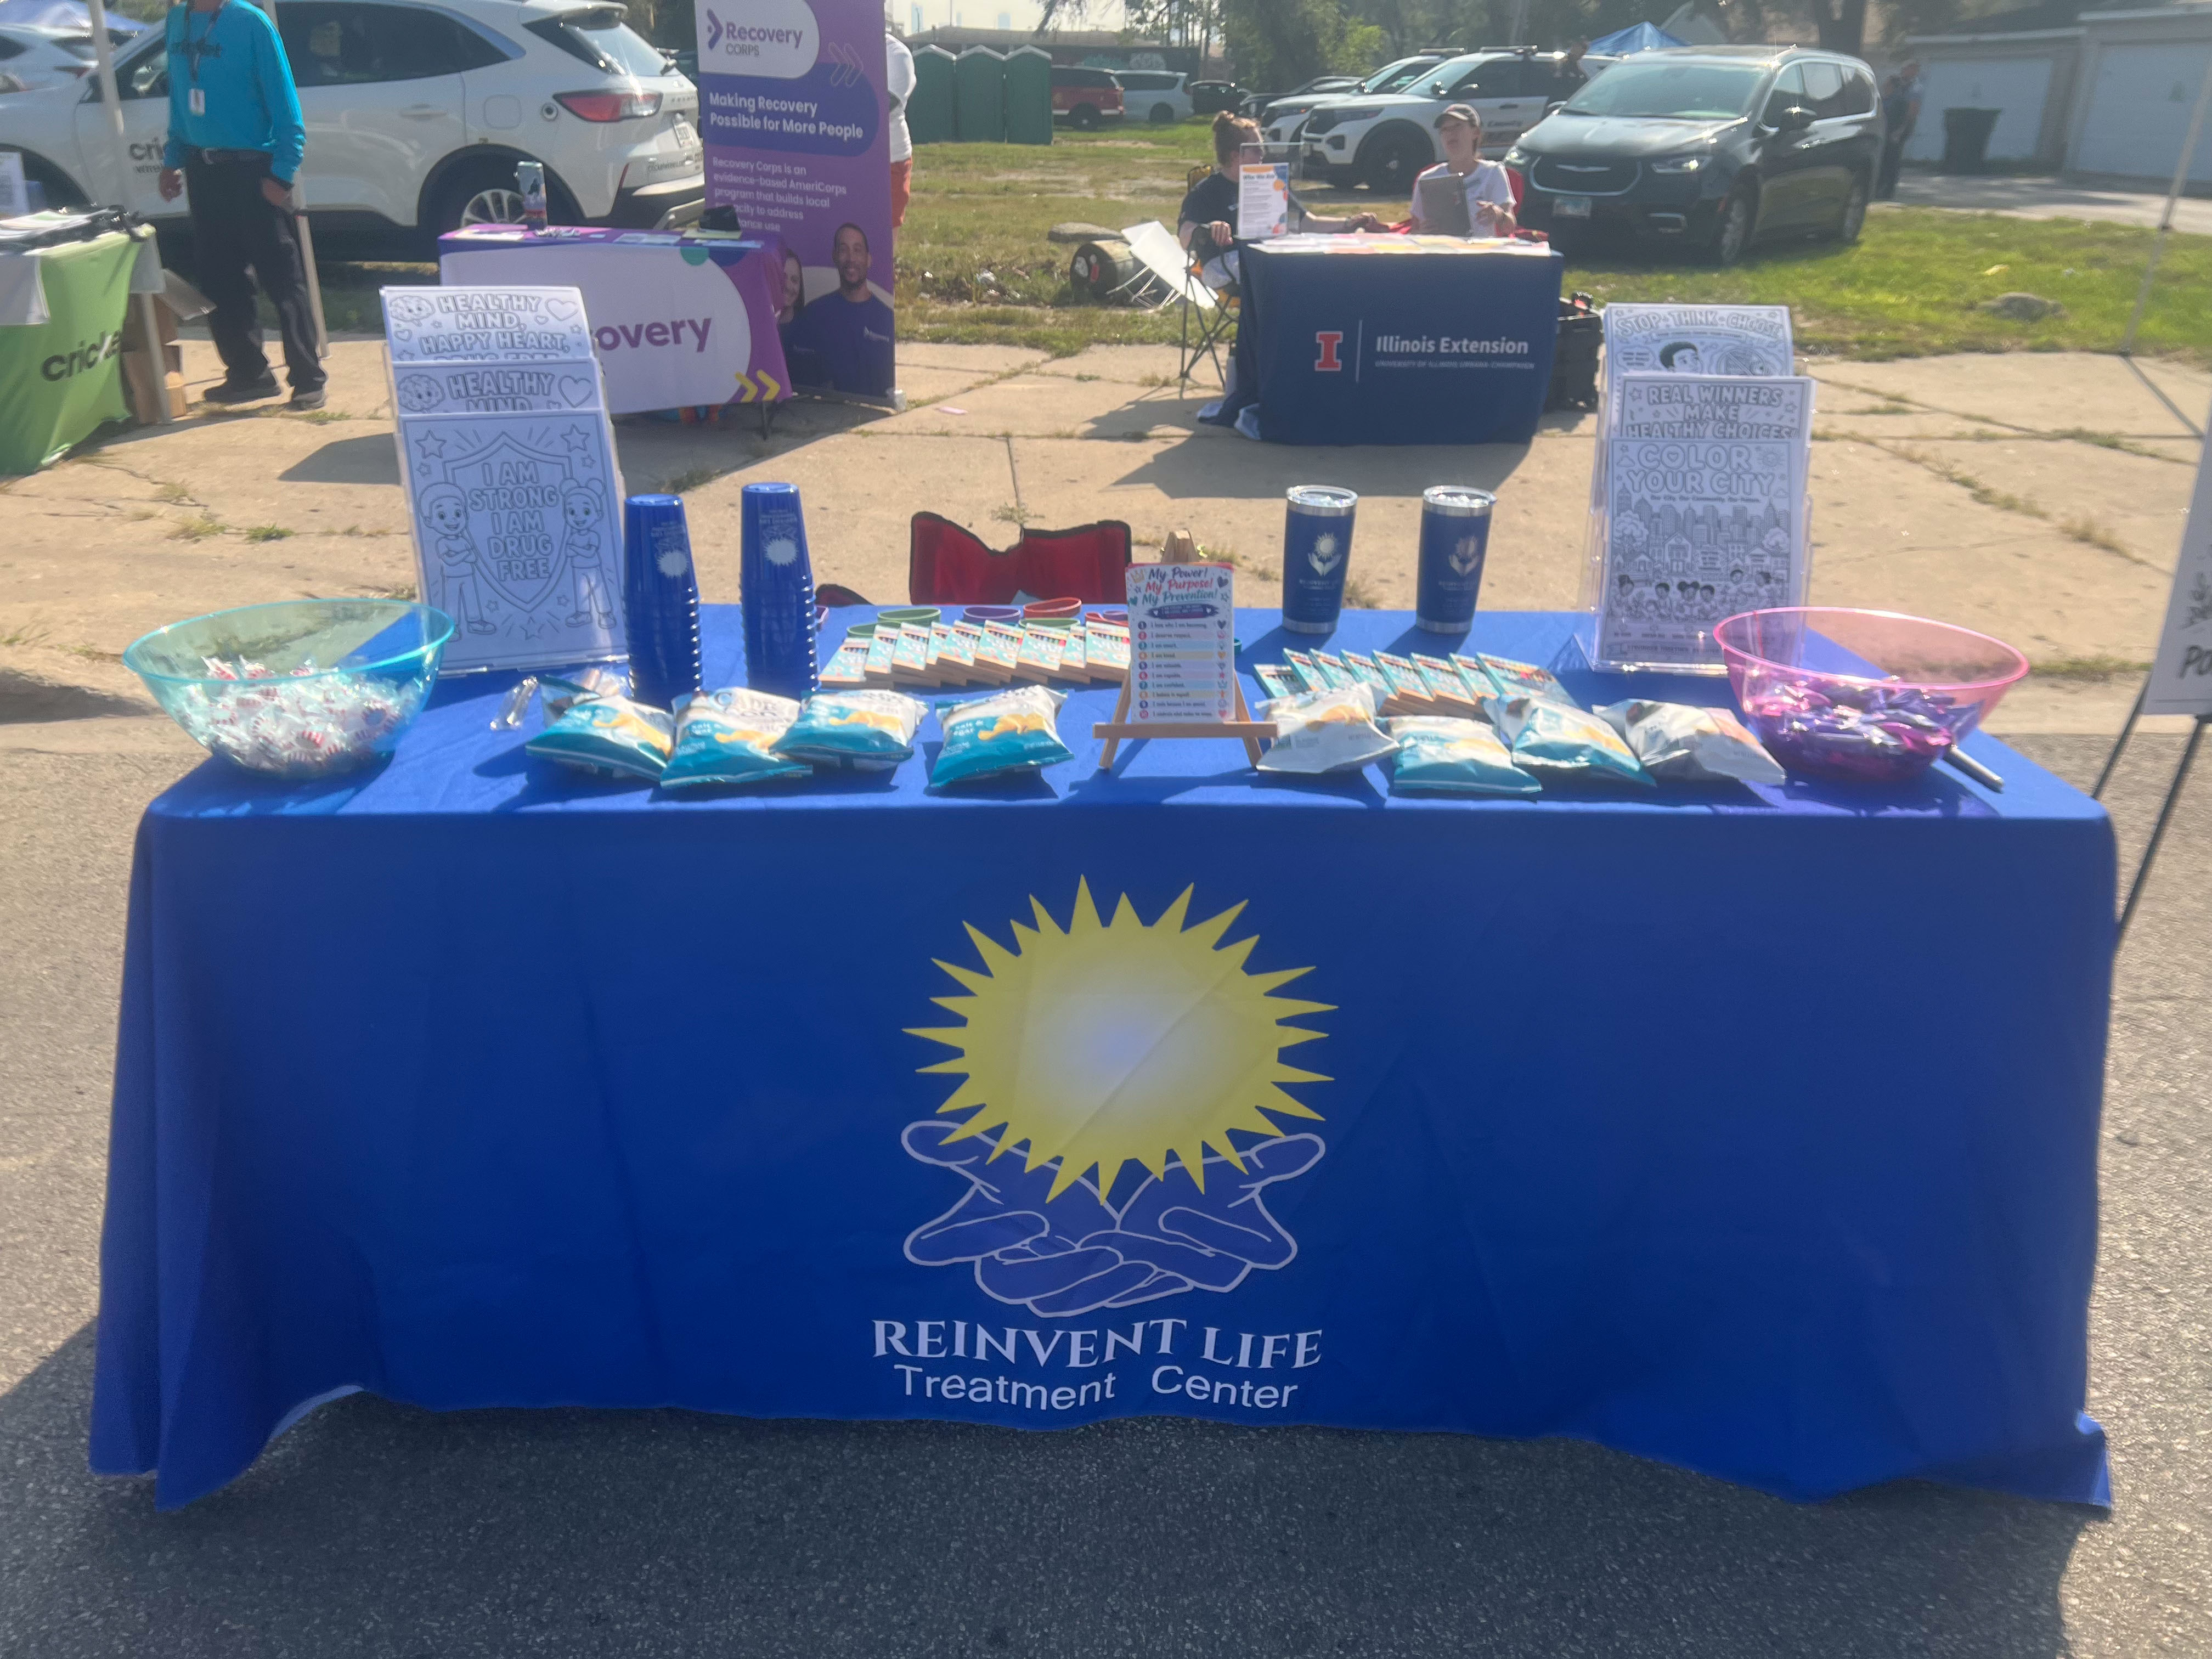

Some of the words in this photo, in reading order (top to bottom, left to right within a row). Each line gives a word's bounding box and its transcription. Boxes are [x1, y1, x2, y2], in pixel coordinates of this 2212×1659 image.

[726, 21, 803, 49] Recovery
[726, 43, 760, 56] CORPS
[709, 92, 756, 113] Making
[758, 96, 817, 118] Recovery
[710, 112, 761, 129] Possible
[763, 116, 780, 131] for
[783, 118, 816, 134] More
[819, 121, 864, 141] People
[713, 156, 755, 172] Recovery
[756, 161, 782, 175] Corps
[784, 163, 792, 173] is
[793, 166, 806, 176] an
[715, 188, 755, 200] program
[756, 191, 774, 201] that
[775, 193, 804, 205] builds
[806, 196, 830, 207] local
[789, 179, 847, 196] AmeriCorps
[757, 206, 765, 216] to
[766, 207, 804, 221] address
[764, 222, 781, 232] use
[436, 294, 542, 313] HEALTHY
[455, 312, 527, 331] MIND,
[1616, 311, 1661, 336] STOP
[1668, 309, 1719, 326] THINK
[417, 331, 492, 355] HAPPY
[494, 331, 571, 354] HEART,
[595, 318, 712, 353] overy
[1376, 335, 1436, 353] Illinois
[1439, 336, 1530, 354] Extension
[445, 370, 555, 400] HEALTHY
[1647, 385, 1695, 405] REAL
[1699, 385, 1784, 407] WINNERS
[1683, 403, 1740, 422] MAKE
[1626, 421, 1709, 439] HEALTHY
[1637, 443, 1752, 472] COLOR
[481, 462, 494, 487] I
[499, 460, 540, 486] AM
[1626, 469, 1704, 494] YOUR
[1711, 471, 1775, 496] CITY
[469, 484, 559, 512] STRONG
[491, 512, 503, 535] I
[506, 510, 545, 534] AM
[487, 533, 554, 560] DRUG
[496, 557, 550, 582] FREE
[1149, 567, 1166, 583] My
[1172, 566, 1209, 579] Power!
[1142, 594, 1159, 606] My
[1163, 589, 1218, 603] Prevention!
[1145, 581, 1163, 595] My
[1167, 578, 1214, 592] Purpose!
[872, 1319, 1187, 1368] REINVENT
[1200, 1329, 1323, 1369] LIFE
[894, 1364, 1116, 1410] Treatment
[1152, 1365, 1298, 1409] Center
